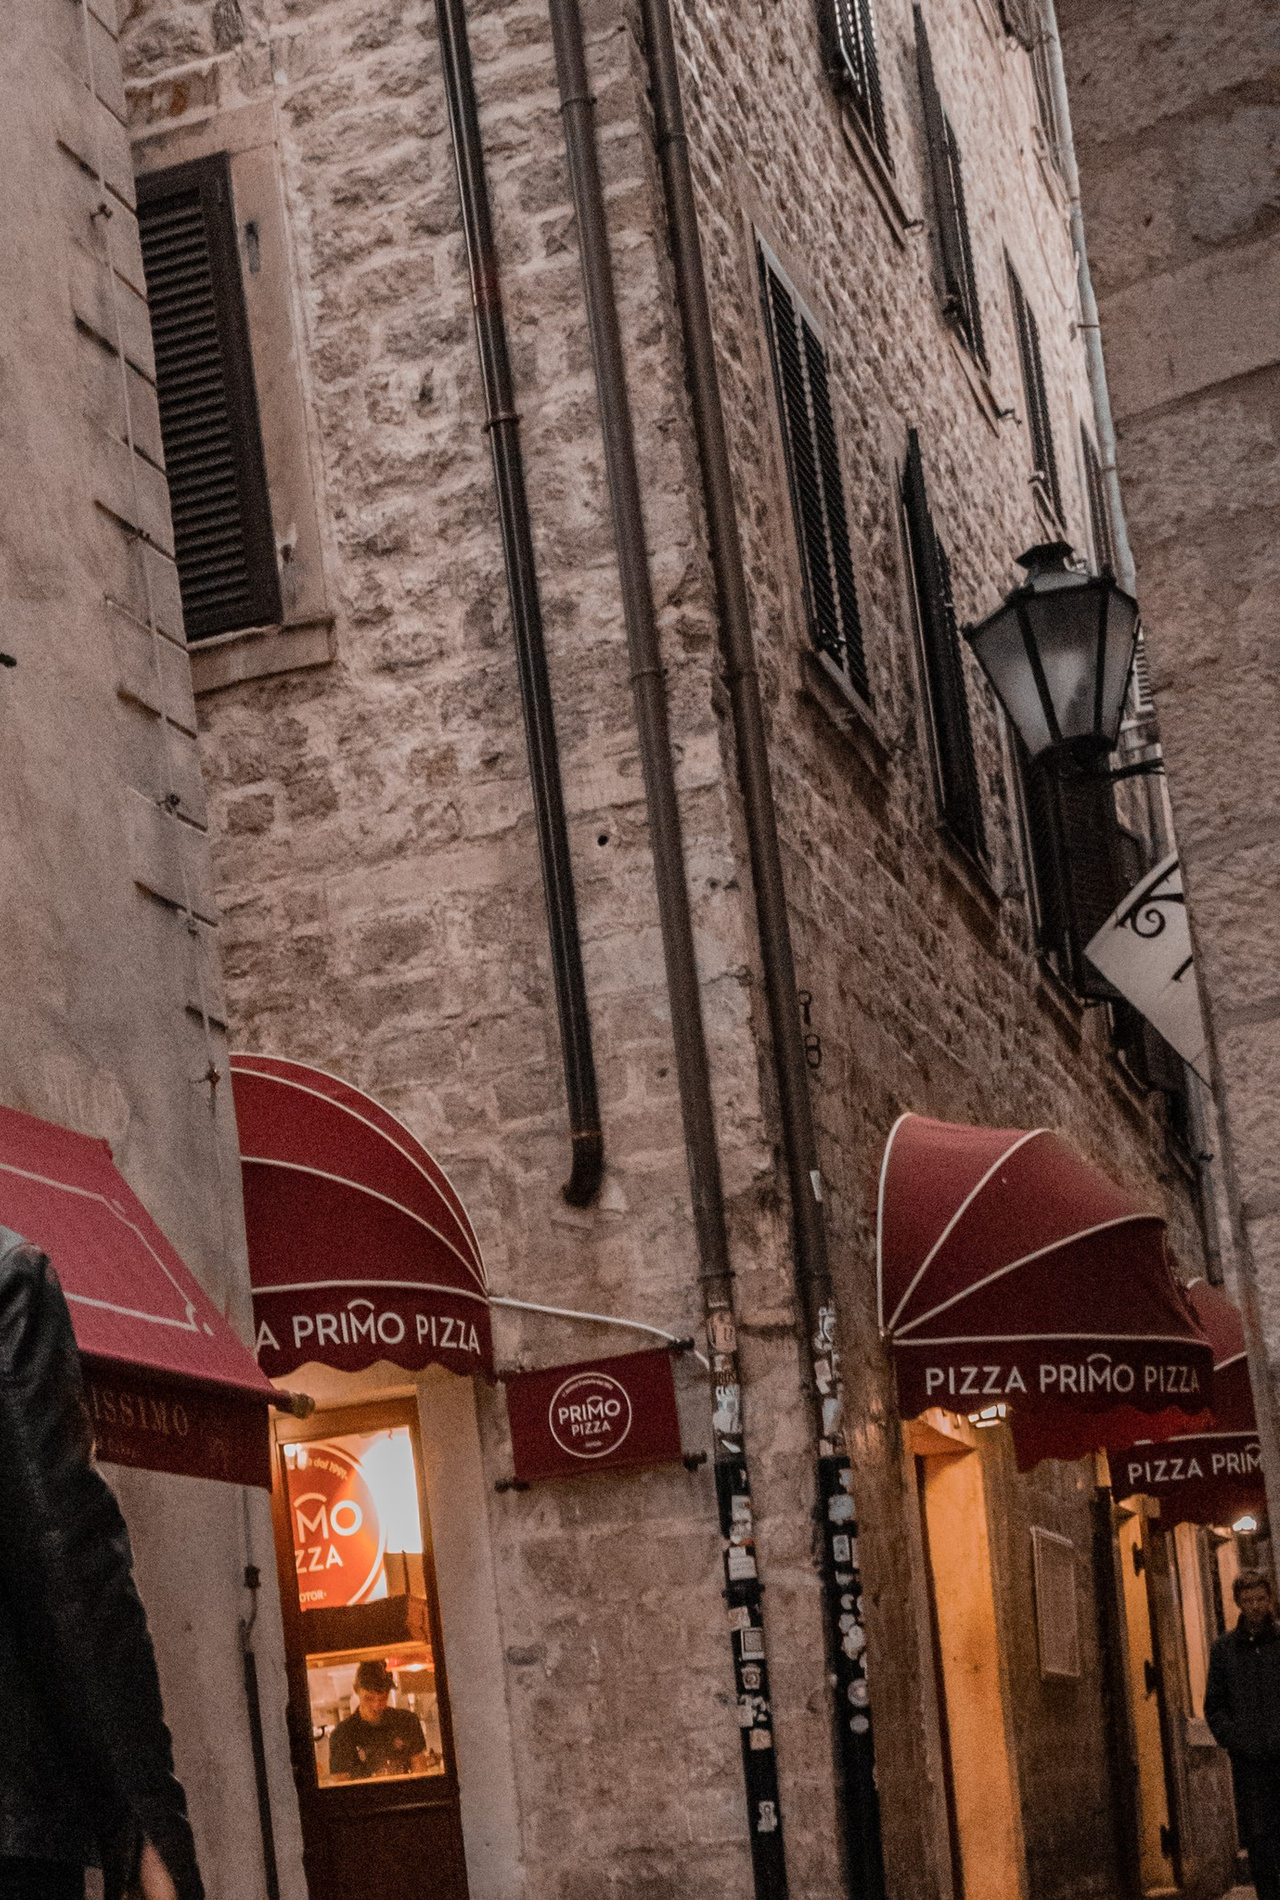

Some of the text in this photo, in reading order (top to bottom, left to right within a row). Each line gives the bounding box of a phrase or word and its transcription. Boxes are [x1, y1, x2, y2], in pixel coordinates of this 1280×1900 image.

[291, 1300, 405, 1349] PRIMO
[415, 1313, 481, 1356] PIZZA
[925, 1354, 1200, 1396] PIZZA PRIMO PIZZA
[558, 1397, 621, 1425] PRIMO
[571, 1420, 612, 1437] PIZZA
[1127, 1457, 1204, 1485] PIZZA
